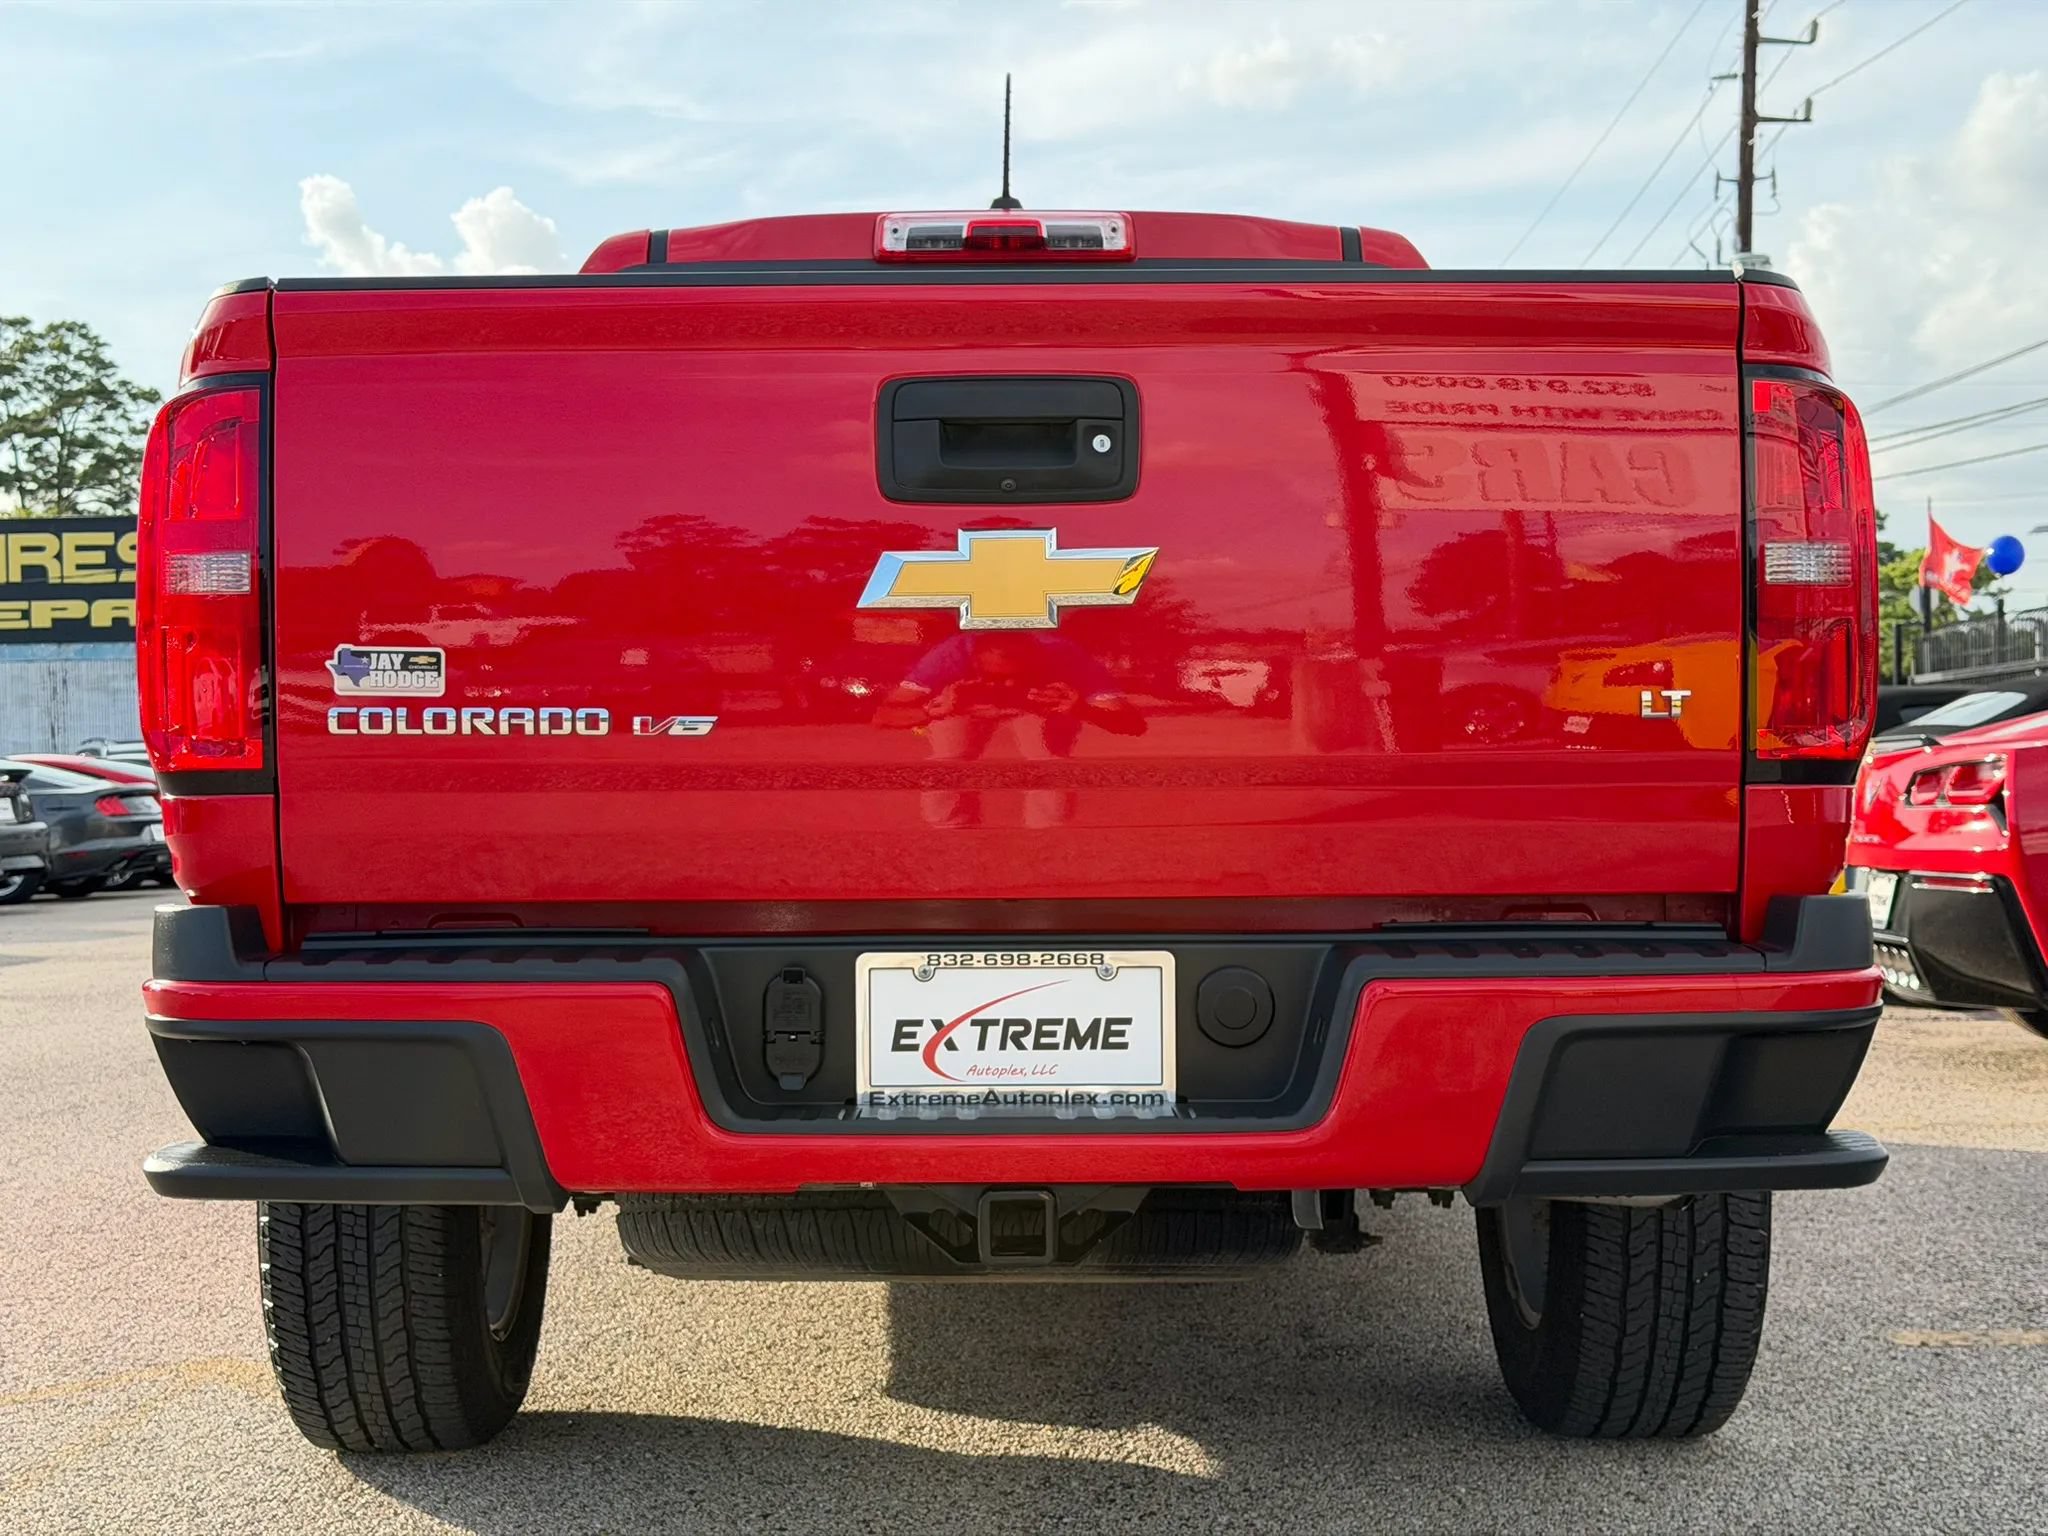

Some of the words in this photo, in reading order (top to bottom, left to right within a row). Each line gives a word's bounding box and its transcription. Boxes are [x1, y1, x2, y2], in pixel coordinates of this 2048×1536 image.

[369, 653, 404, 670] JAY
[369, 670, 439, 689] HODGE
[1640, 690, 1692, 719] LT
[327, 706, 610, 736] COLORADO
[633, 715, 719, 736] V6
[926, 953, 1105, 967] 832-698-2668
[891, 1016, 1133, 1052] EXTREME
[966, 1064, 1027, 1078] Autoplex,
[1031, 1064, 1059, 1076] LLC
[868, 1089, 1165, 1107] ExtremeAutoplex.com
